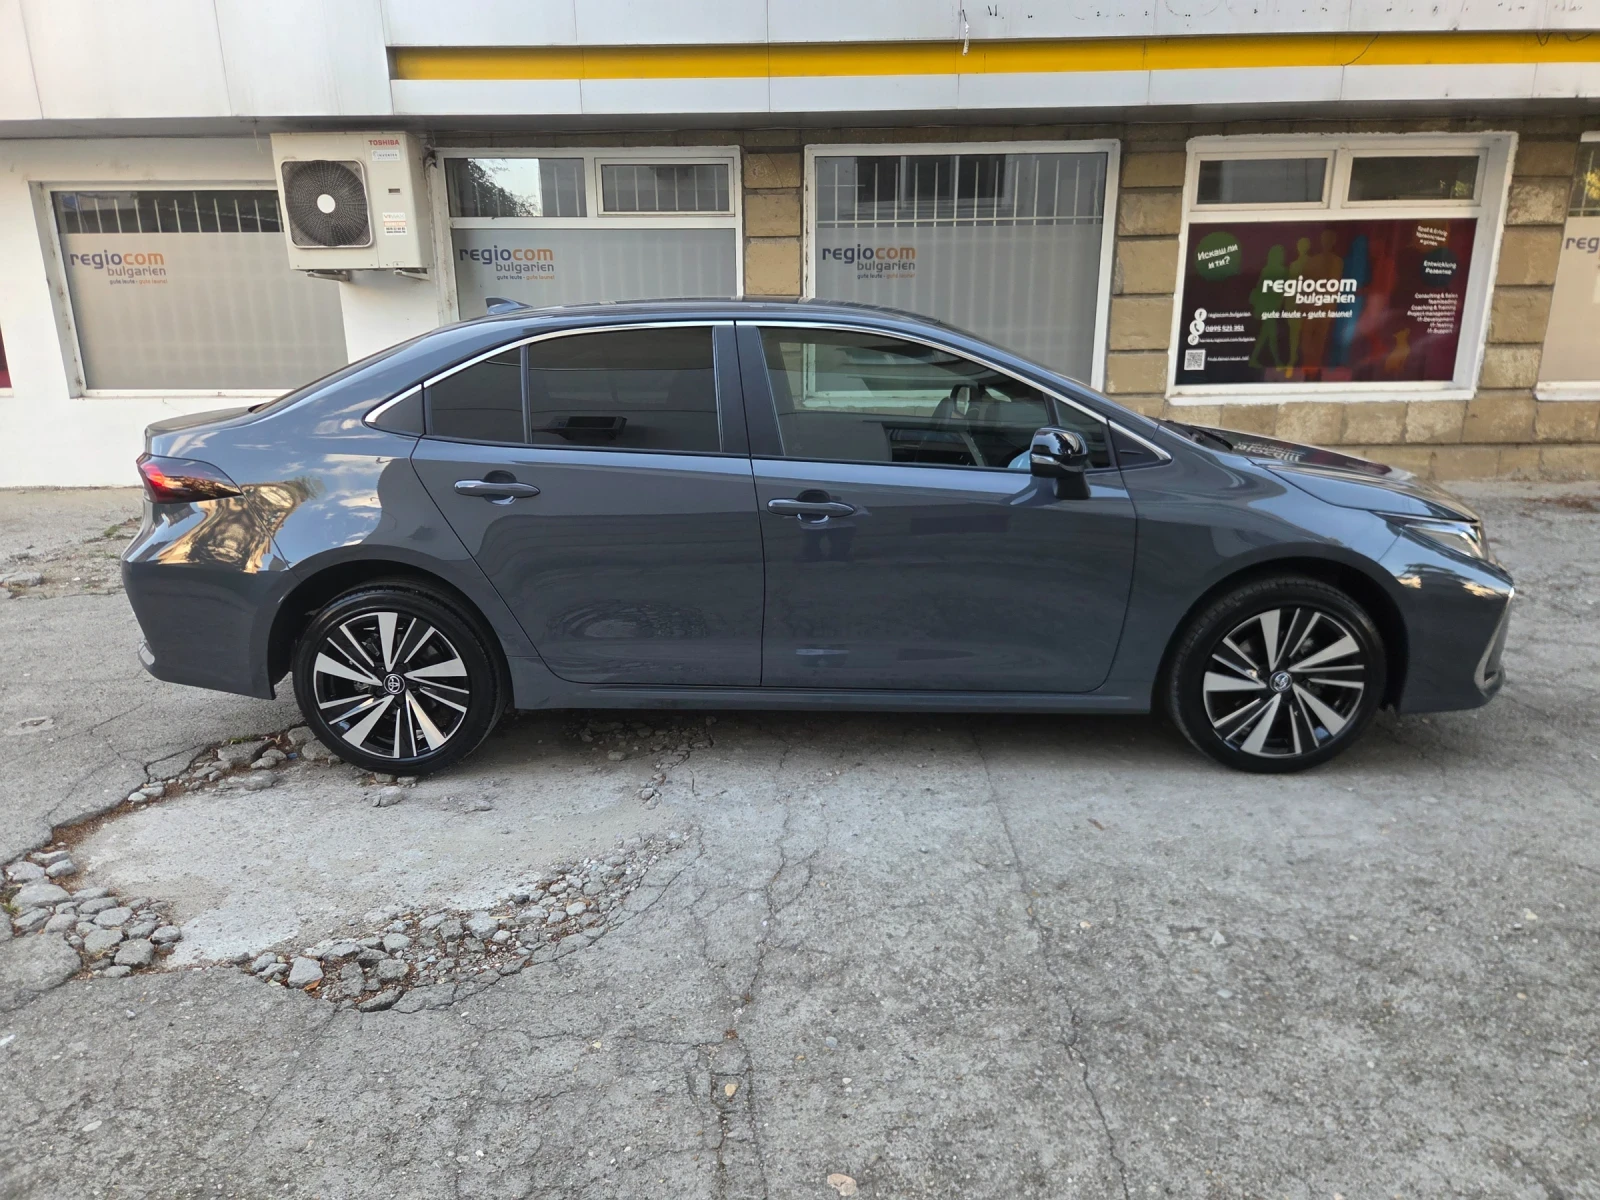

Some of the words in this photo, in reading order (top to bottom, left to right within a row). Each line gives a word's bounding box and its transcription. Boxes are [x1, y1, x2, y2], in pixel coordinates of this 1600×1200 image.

[70, 250, 165, 269] regiocom
[458, 245, 554, 265] regiocom
[822, 244, 916, 264] regiocom
[1197, 247, 1227, 261] Искаш
[1227, 243, 1238, 253] ли
[107, 266, 167, 278] bulgarien
[495, 262, 555, 274] bulgarien
[857, 260, 915, 272] bulgarien
[1262, 275, 1358, 297] regiocom
[1295, 292, 1356, 306] bulgarien
[1261, 310, 1280, 320] gute
[1281, 309, 1302, 319] leute
[1307, 309, 1327, 319] gute
[1327, 309, 1353, 318] laune!
